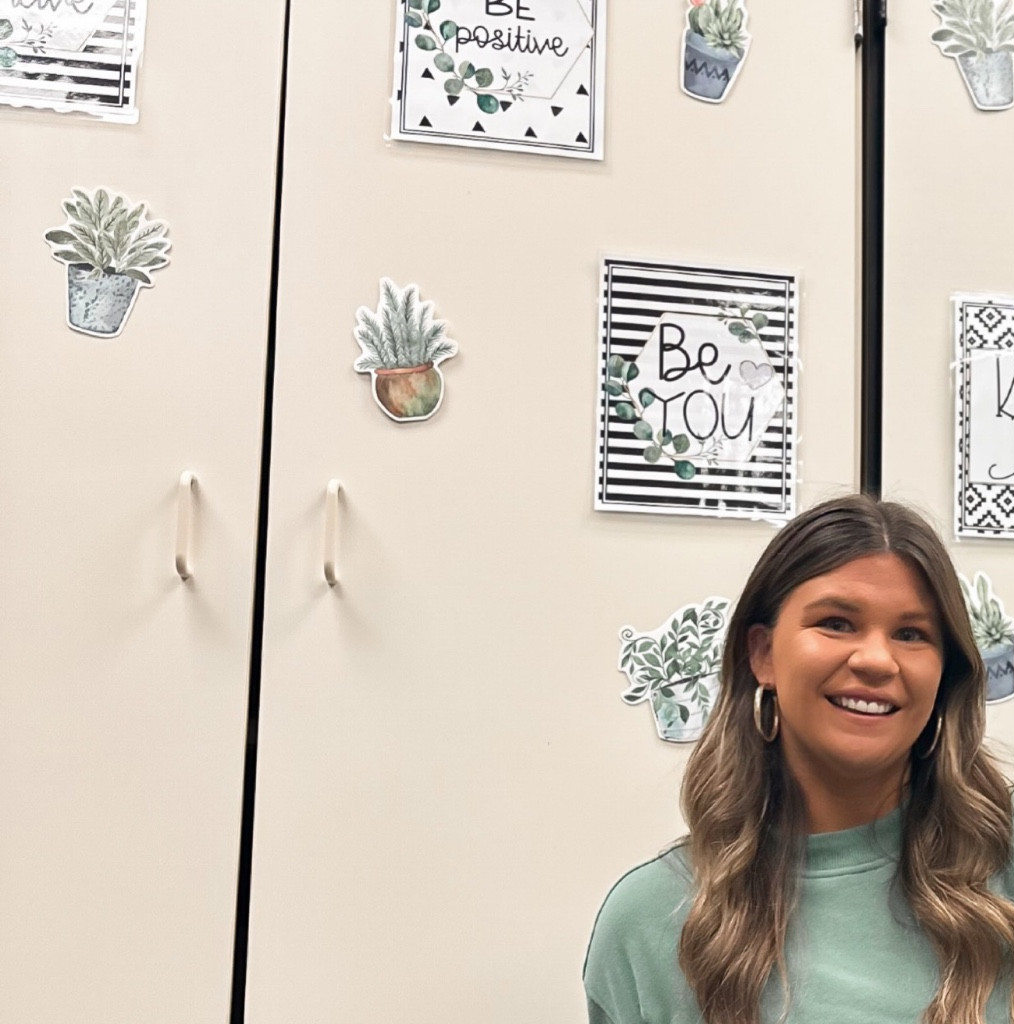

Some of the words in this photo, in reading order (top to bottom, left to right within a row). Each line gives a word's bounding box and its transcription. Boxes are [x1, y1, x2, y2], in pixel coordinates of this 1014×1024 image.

[455, 25, 569, 57] positive
[658, 322, 732, 385] Be
[645, 388, 755, 443] YOU
